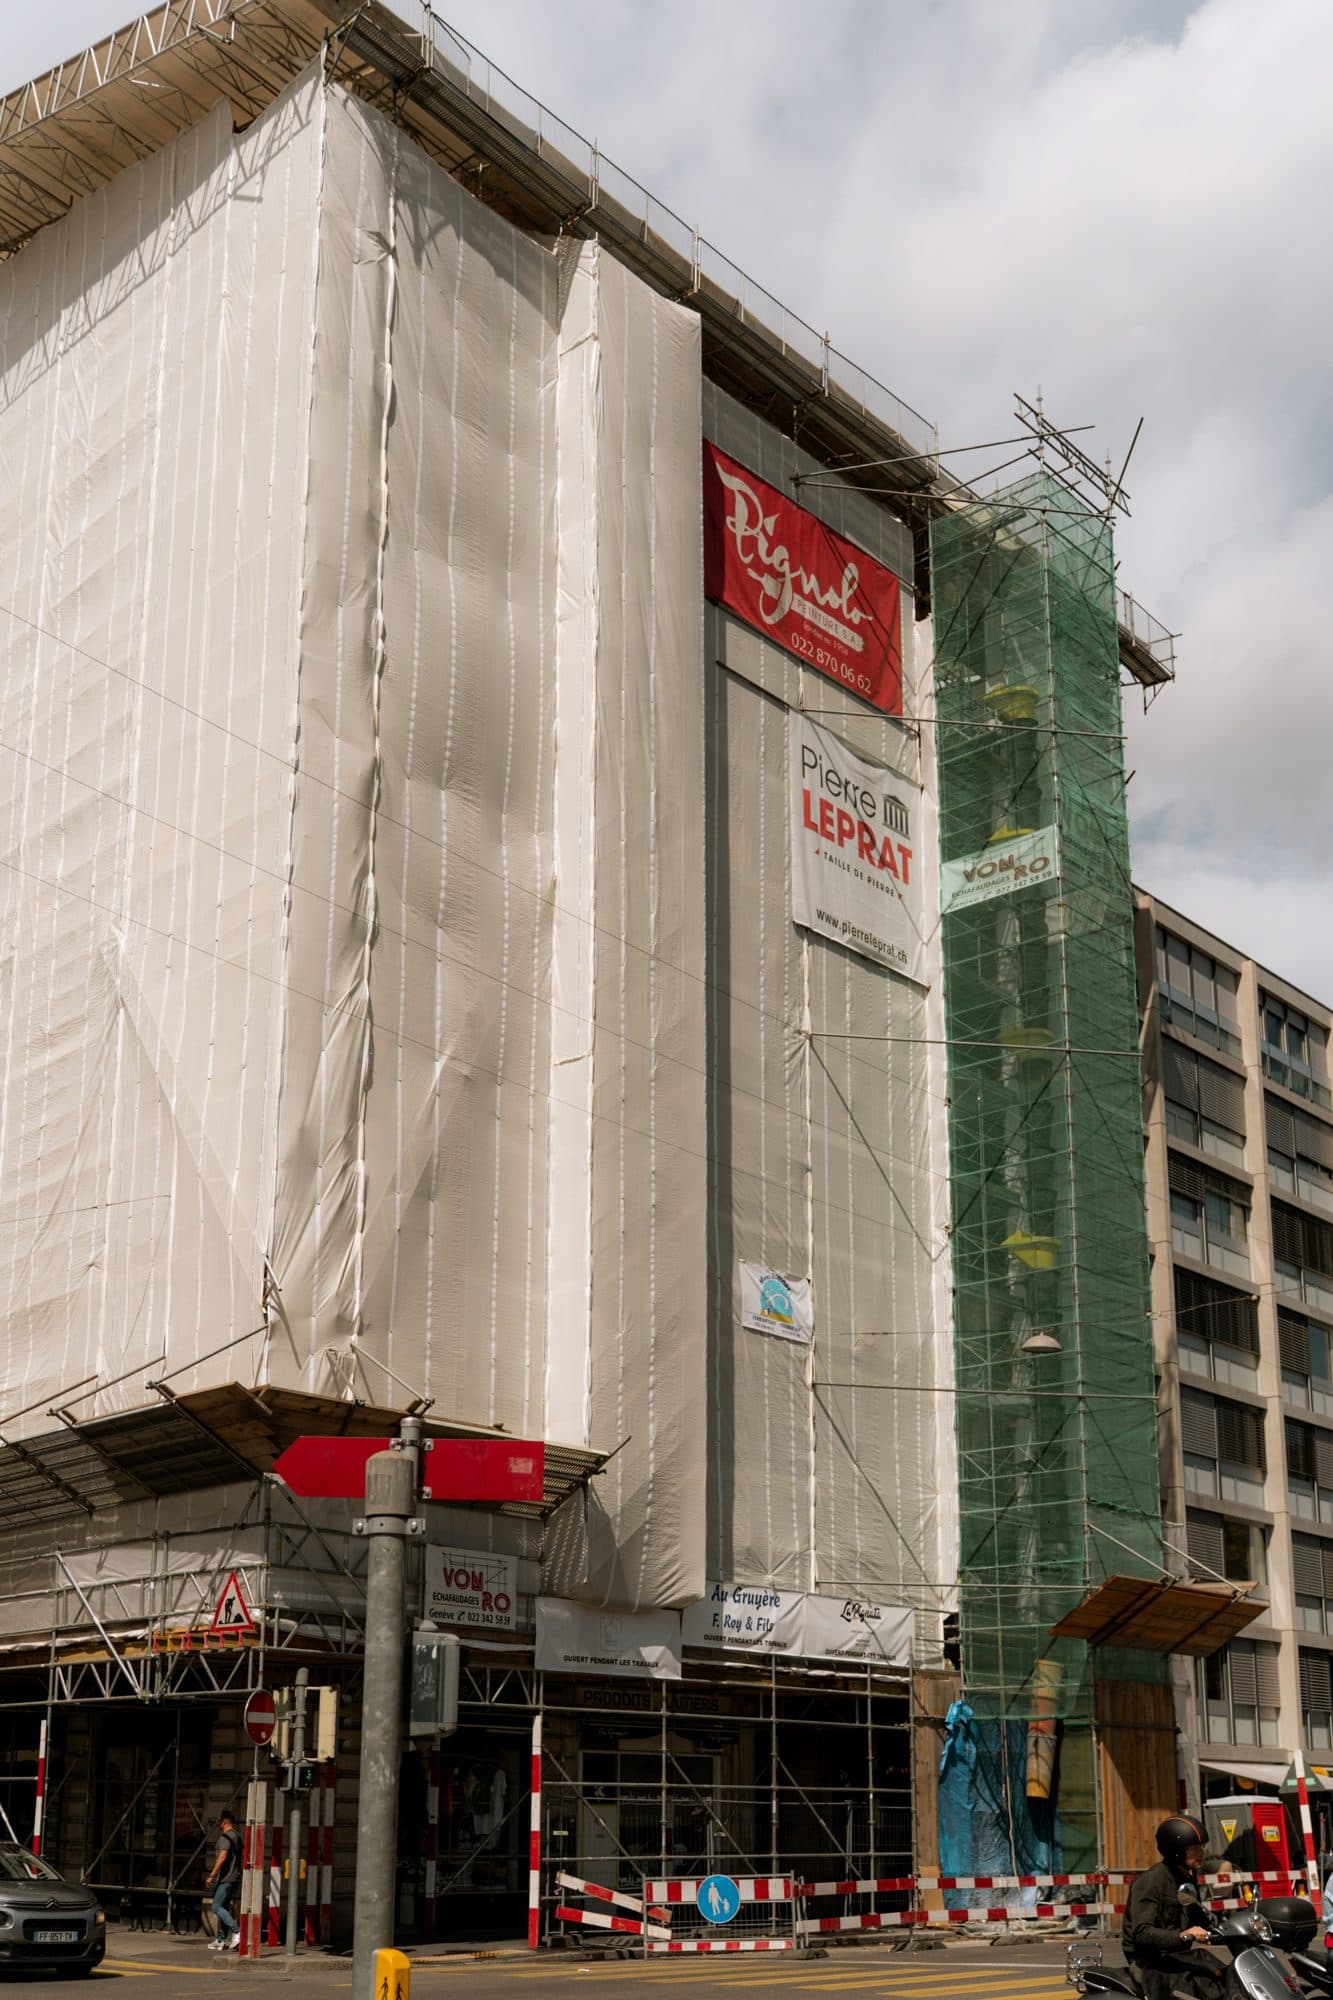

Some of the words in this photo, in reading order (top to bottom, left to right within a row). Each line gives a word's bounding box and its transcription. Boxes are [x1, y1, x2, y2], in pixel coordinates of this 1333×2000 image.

[791, 632, 814, 658] 022
[816, 647, 838, 672] 870
[841, 663, 855, 683] 06
[857, 674, 872, 694] 62
[802, 744, 877, 818] Pierre
[803, 787, 912, 885] LEPRAT
[824, 851, 851, 873] TAILLE
[854, 868, 863, 880] DE
[867, 875, 894, 897] PIERRE
[963, 854, 1014, 883] VON
[1013, 856, 1050, 880] RO
[816, 908, 907, 964] www.pierreleprat.ch
[432, 1591, 480, 1606] ECHAFAUDAGES
[443, 1567, 484, 1591] VON
[482, 1591, 511, 1613] RO
[711, 1584, 728, 1602] Au
[732, 1586, 781, 1611] Gruyère
[429, 1608, 455, 1620] Genève
[467, 1611, 480, 1622] 022
[482, 1613, 494, 1624] 342
[712, 1613, 720, 1628] F.
[723, 1614, 742, 1632] Roy
[745, 1616, 753, 1631] &
[756, 1617, 775, 1632] Fils
[840, 1600, 852, 1622] La
[703, 1633, 727, 1641] OUVERT
[727, 1635, 752, 1645] PENDANT
[563, 1654, 589, 1664] OUVERT
[590, 1656, 619, 1665] PENDANT
[619, 1658, 631, 1667] LES
[632, 1660, 659, 1668] TRAVAUX
